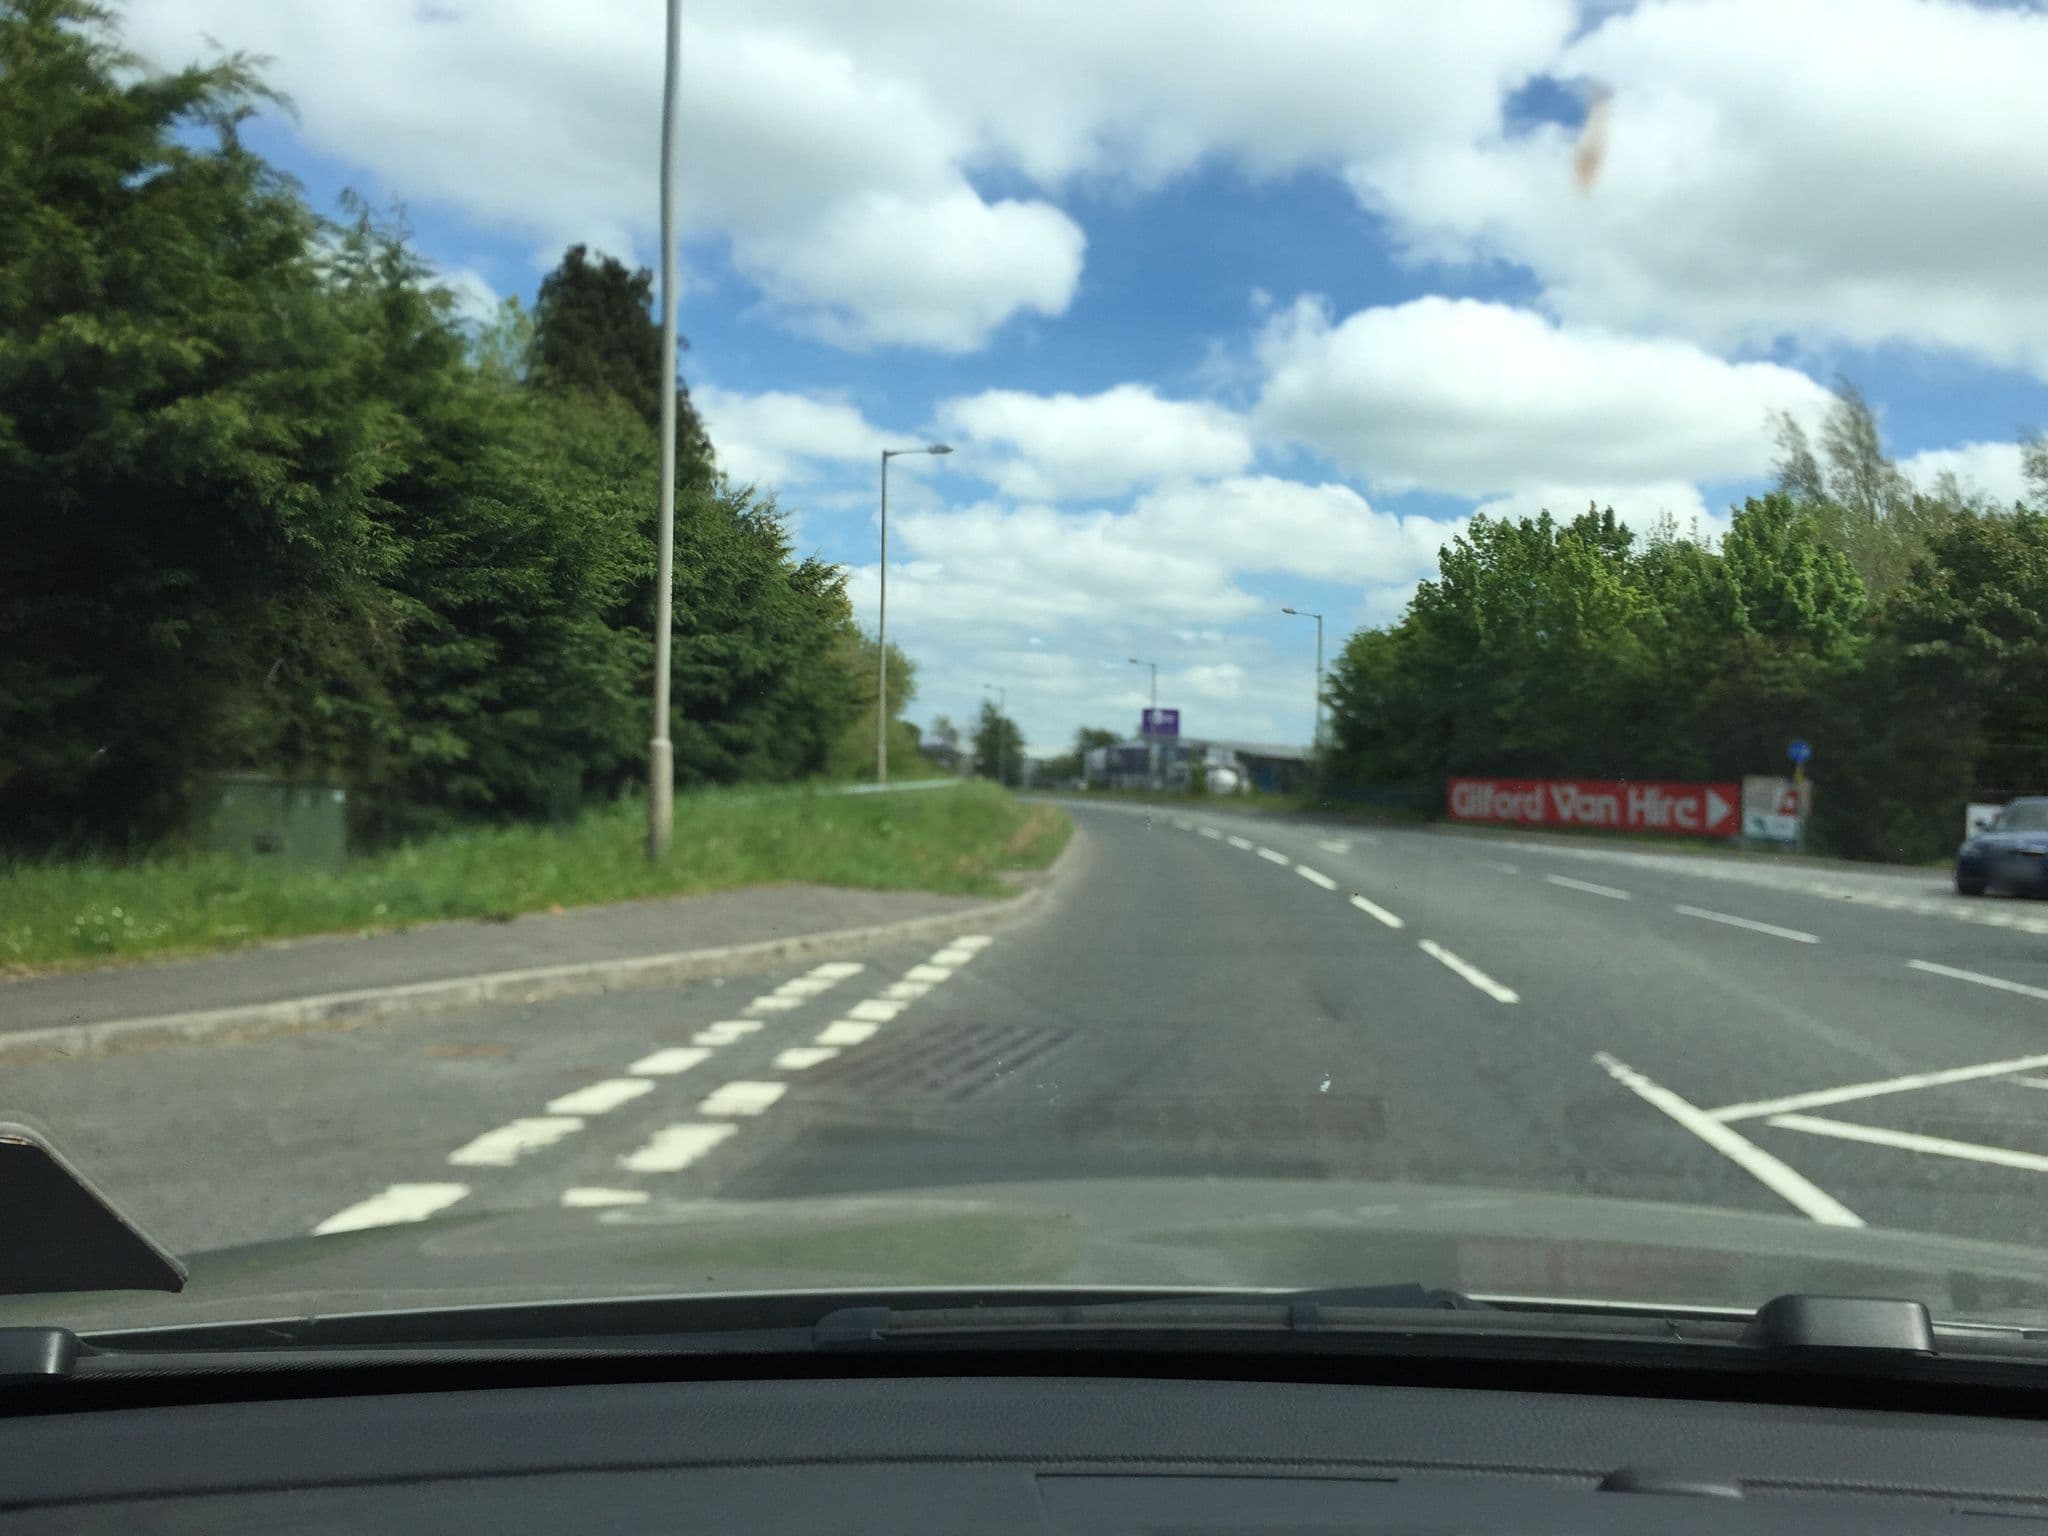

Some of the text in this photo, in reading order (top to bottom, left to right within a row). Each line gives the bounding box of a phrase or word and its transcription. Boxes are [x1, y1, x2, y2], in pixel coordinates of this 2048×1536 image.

[1451, 783, 1698, 827] Gilford Van Hire
